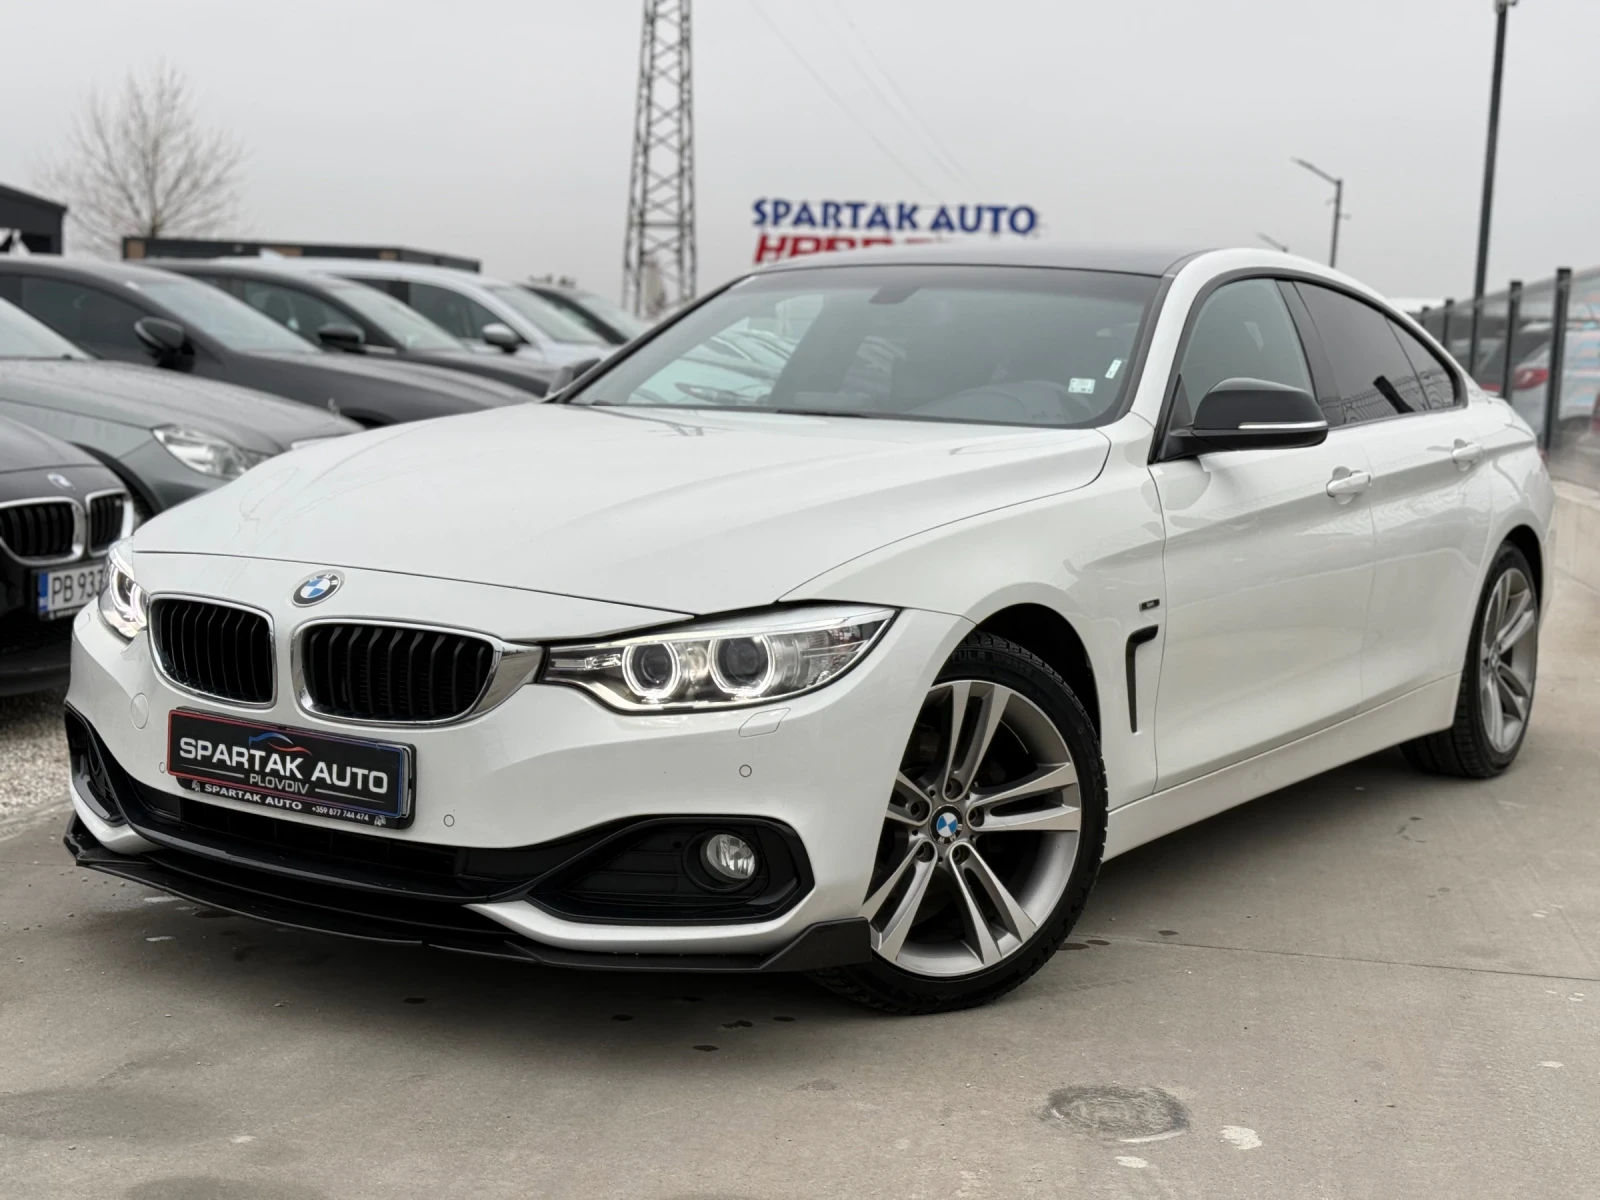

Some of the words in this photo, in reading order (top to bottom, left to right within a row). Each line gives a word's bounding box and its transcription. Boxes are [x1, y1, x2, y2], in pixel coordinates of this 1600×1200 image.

[752, 197, 920, 230] SPARTAK
[930, 204, 1039, 234] AUTO
[52, 575, 74, 605] PB
[179, 737, 304, 778] SPARTAK
[310, 761, 389, 794] AUTO
[204, 783, 262, 803] SPARTAK
[265, 795, 302, 810] AUTO
[250, 774, 309, 794] PLOVDIV
[312, 805, 327, 815] +359
[329, 807, 341, 817] 877
[343, 810, 355, 819] 744
[356, 813, 369, 821] 474
